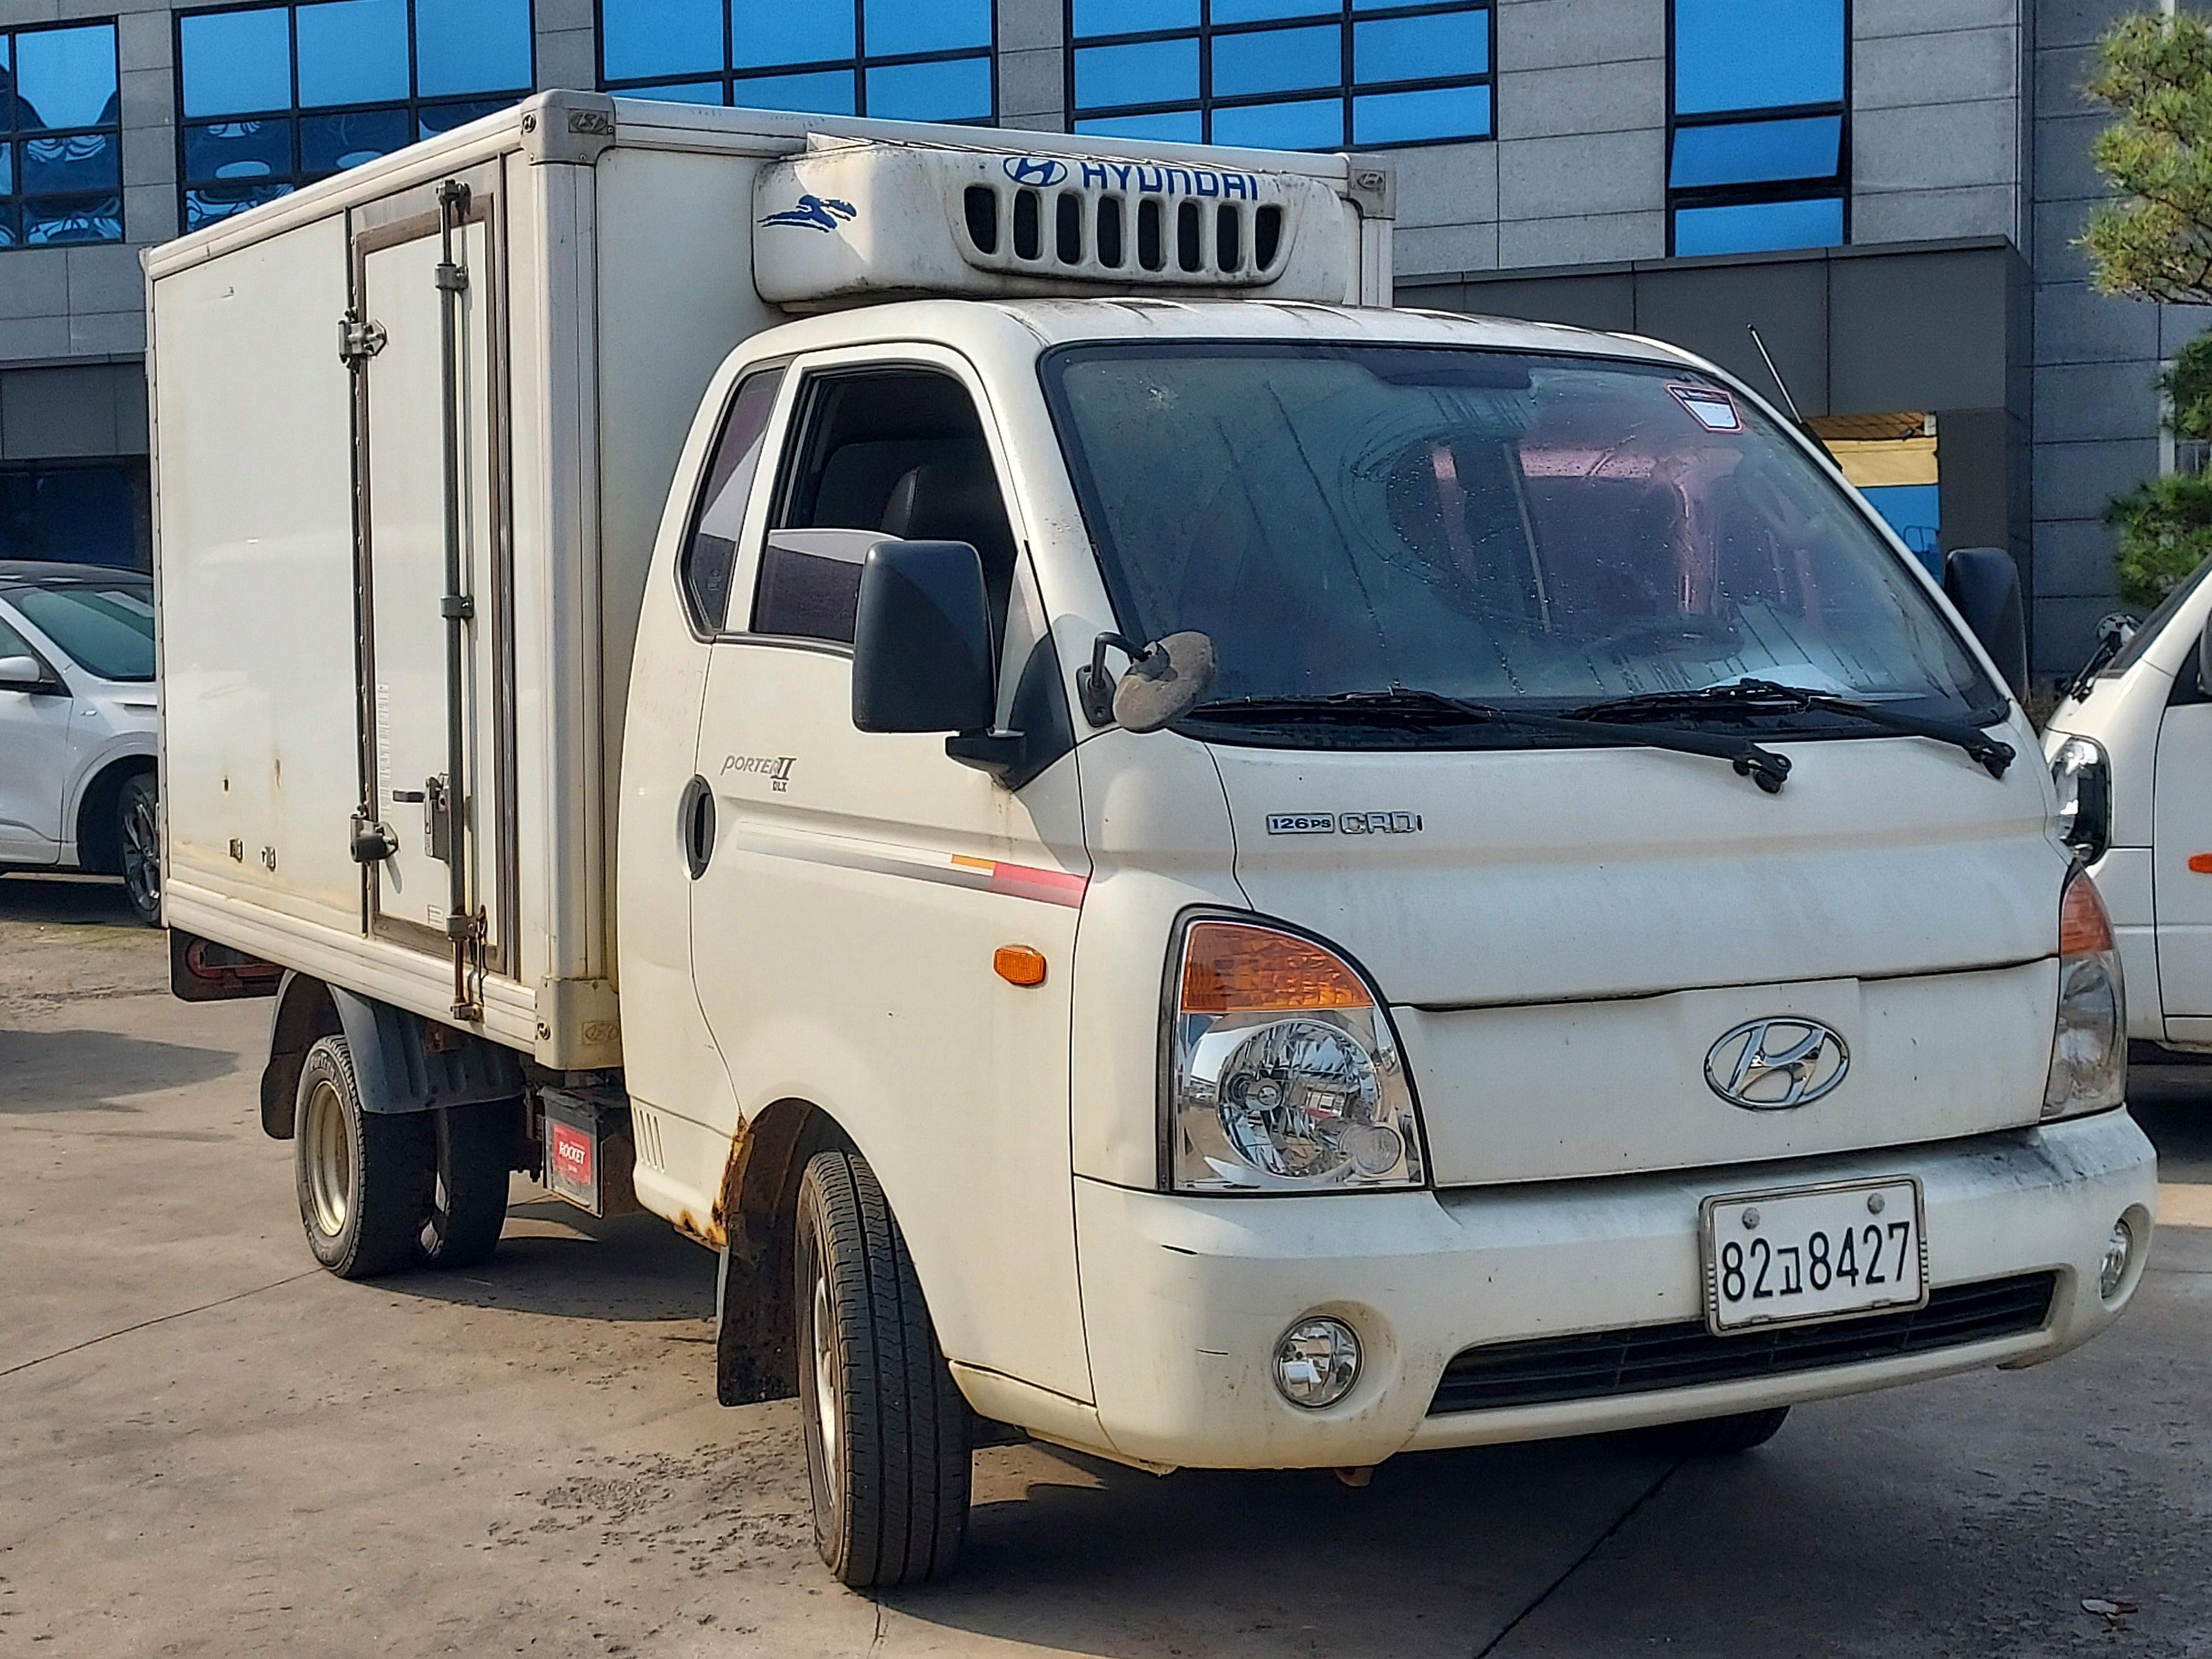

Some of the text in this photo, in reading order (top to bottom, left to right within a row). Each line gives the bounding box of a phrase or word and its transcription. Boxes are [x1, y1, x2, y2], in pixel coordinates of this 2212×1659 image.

[1079, 161, 1258, 201] HYUNDAI
[720, 755, 780, 776] PORTER
[773, 781, 787, 792] DLX
[559, 1141, 586, 1165] ROCKET
[1722, 1221, 1910, 1302] 82고8427
